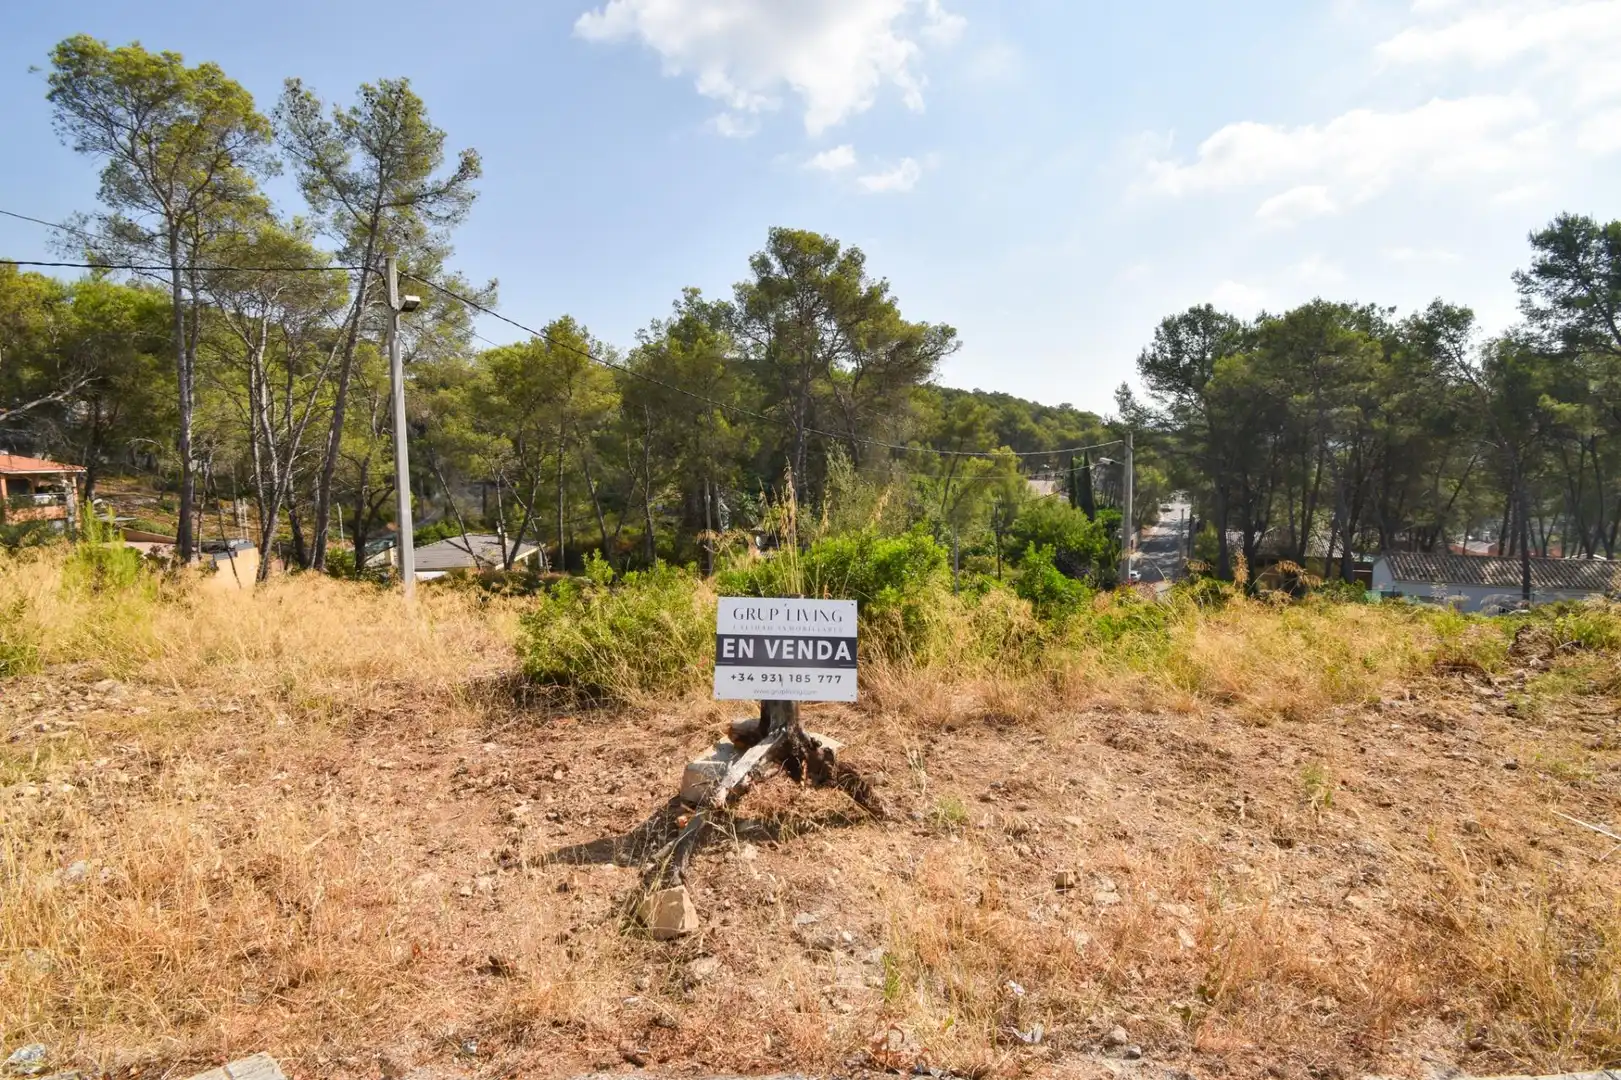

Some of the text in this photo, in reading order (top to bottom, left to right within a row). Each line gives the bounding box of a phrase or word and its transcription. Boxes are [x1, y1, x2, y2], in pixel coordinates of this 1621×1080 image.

[733, 608, 842, 622] GRUP LIVING
[723, 638, 852, 661] EN VENDA
[731, 673, 842, 684] +34 931 185 777
